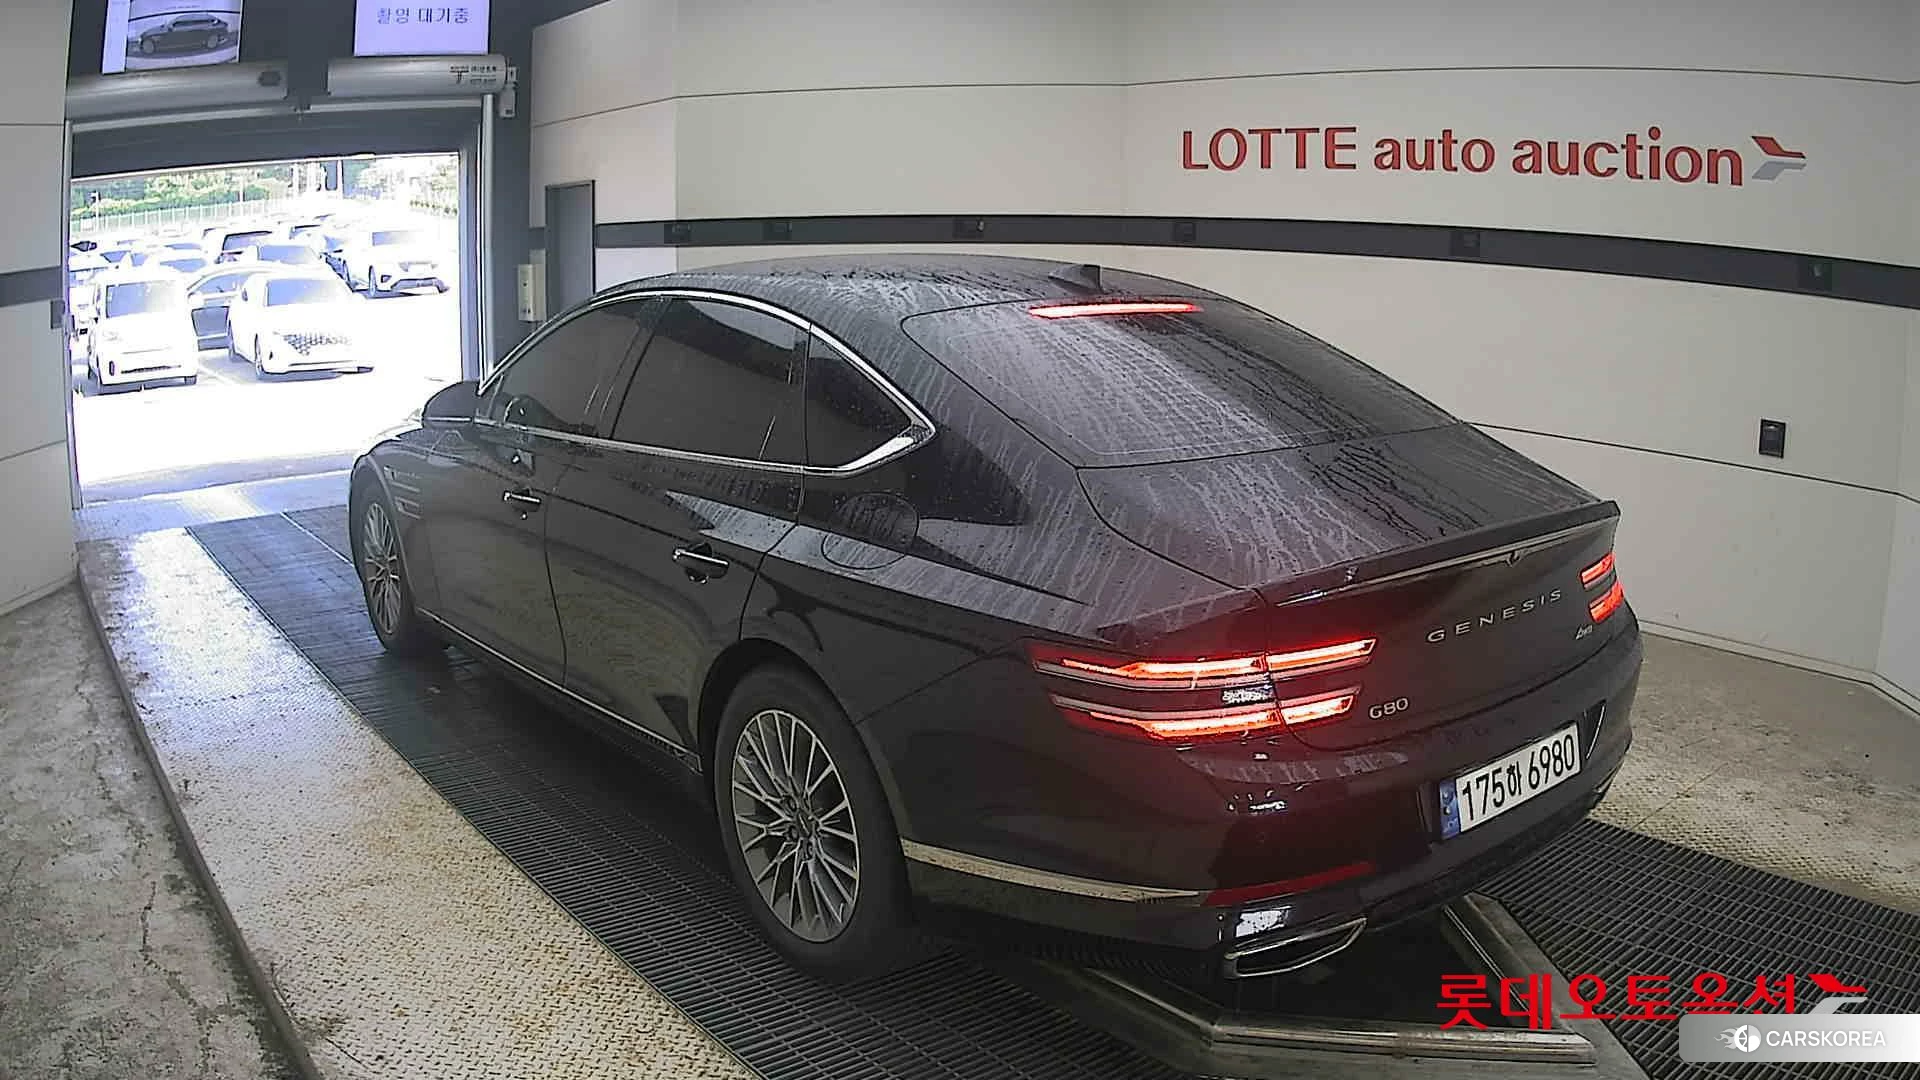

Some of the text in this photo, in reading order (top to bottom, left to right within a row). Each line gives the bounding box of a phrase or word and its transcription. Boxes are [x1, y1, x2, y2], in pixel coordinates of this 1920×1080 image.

[418, 8, 468, 23] 대기중
[1182, 126, 1744, 187] LOTTE auto auction
[1426, 589, 1562, 643] GENESIS
[1368, 697, 1410, 720] G80
[1528, 734, 1575, 790] 6980
